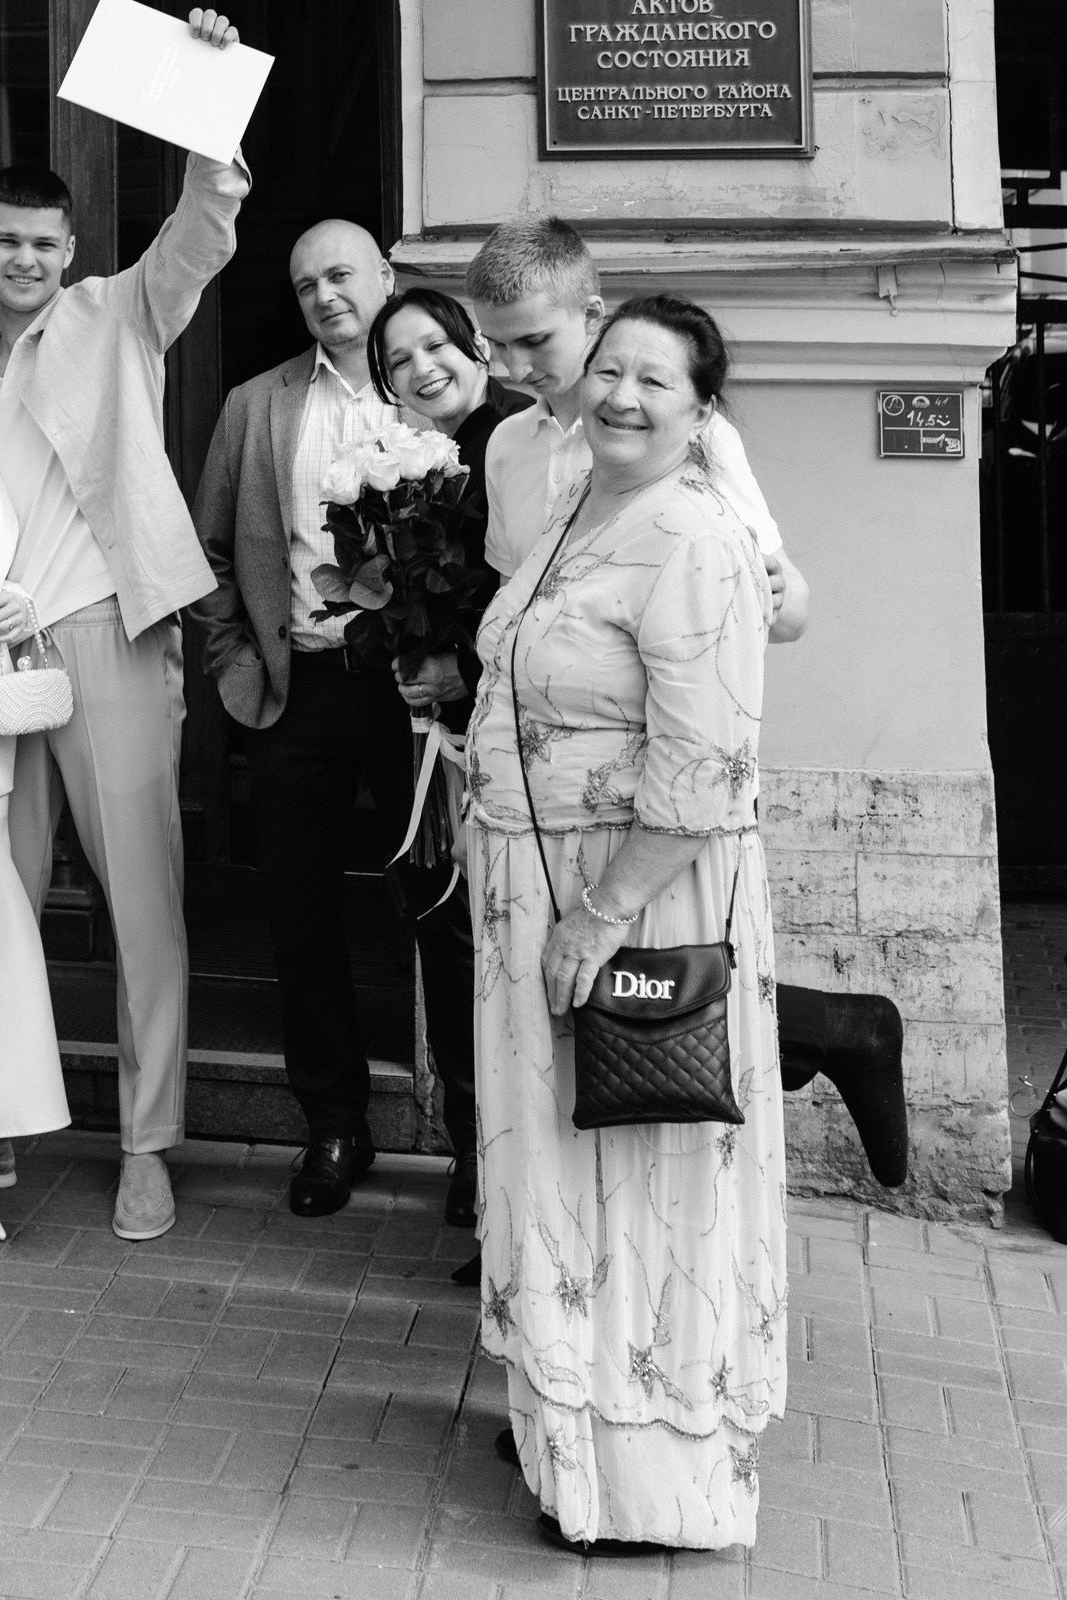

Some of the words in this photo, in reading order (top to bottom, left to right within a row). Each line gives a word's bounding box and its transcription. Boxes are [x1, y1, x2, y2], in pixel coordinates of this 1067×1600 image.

[569, 21, 776, 44] ГРАЖДАНСКОГО
[597, 49, 749, 69] СОСТОЯНИЯ
[558, 85, 707, 102] ЦЕНТРАЛЬНОГО
[718, 82, 792, 98] РАЙОНА
[577, 103, 773, 120] САНКТ-ПЕТЕРБУРГА
[612, 971, 675, 999] Dior
